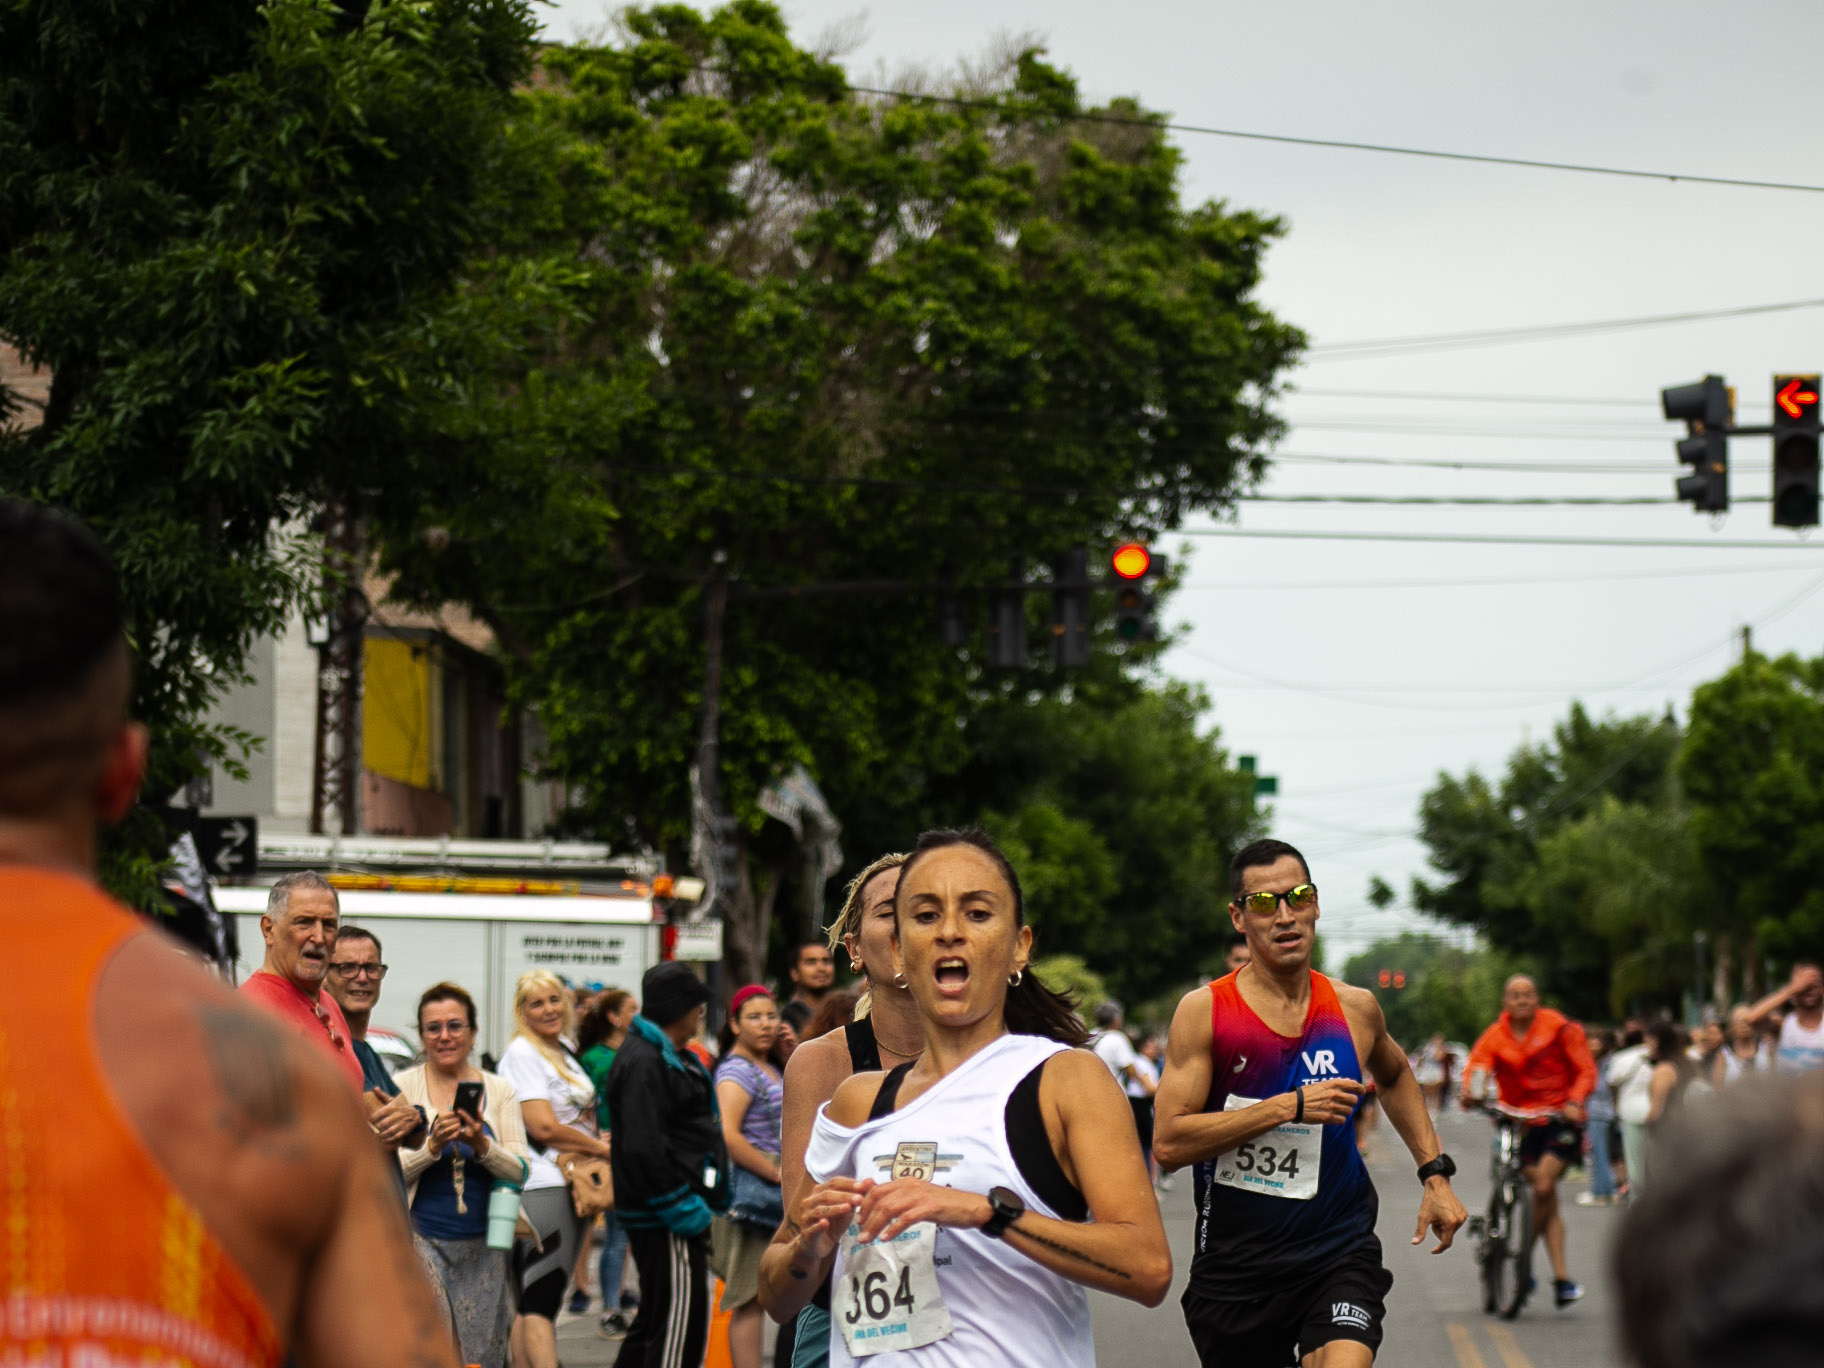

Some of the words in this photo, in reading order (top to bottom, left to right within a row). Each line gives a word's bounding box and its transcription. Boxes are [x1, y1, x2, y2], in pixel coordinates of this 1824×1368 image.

[1301, 1049, 1339, 1076] VR
[1235, 1143, 1300, 1180] 534
[1331, 1302, 1350, 1317] VR
